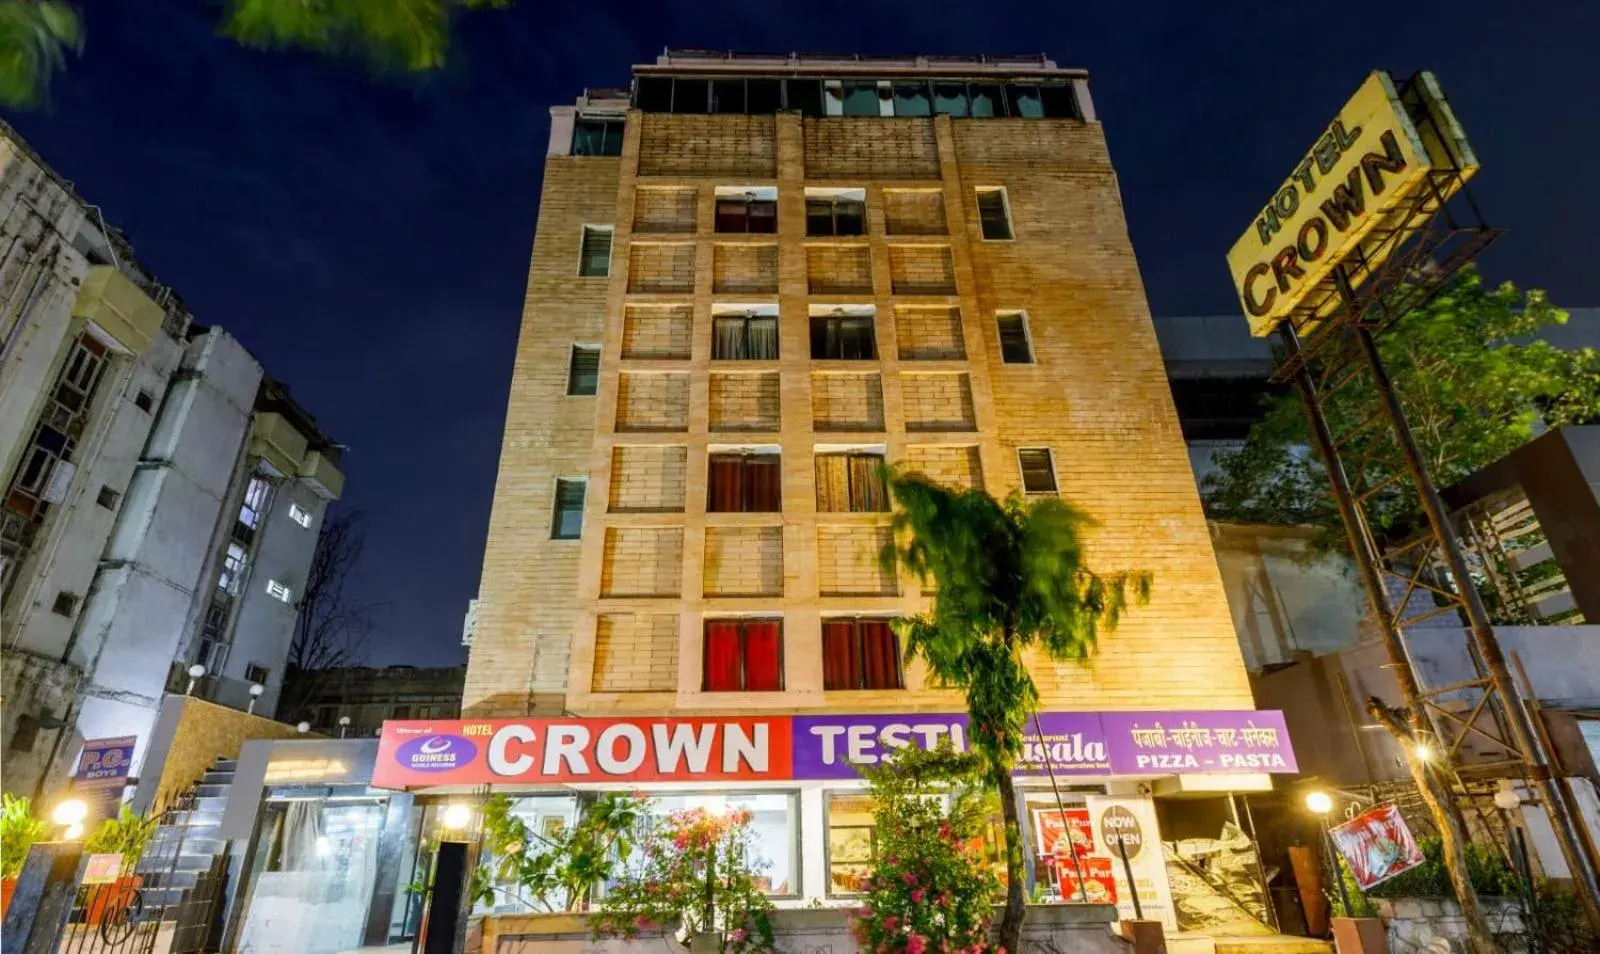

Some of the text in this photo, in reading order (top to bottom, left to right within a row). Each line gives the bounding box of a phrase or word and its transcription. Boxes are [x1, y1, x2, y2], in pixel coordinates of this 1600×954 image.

[1254, 117, 1363, 246] HOTEL
[1242, 128, 1408, 318] CROWN
[462, 723, 493, 736] HOTEL
[485, 722, 771, 777] CROWN
[1014, 732, 1107, 762] asala
[411, 752, 457, 763] GUINESS
[1136, 753, 1200, 769] PIZZA
[1219, 753, 1286, 768] PASTA
[86, 769, 118, 780] BOYS
[1103, 816, 1135, 828] NOW
[1105, 833, 1141, 846] OPEN
